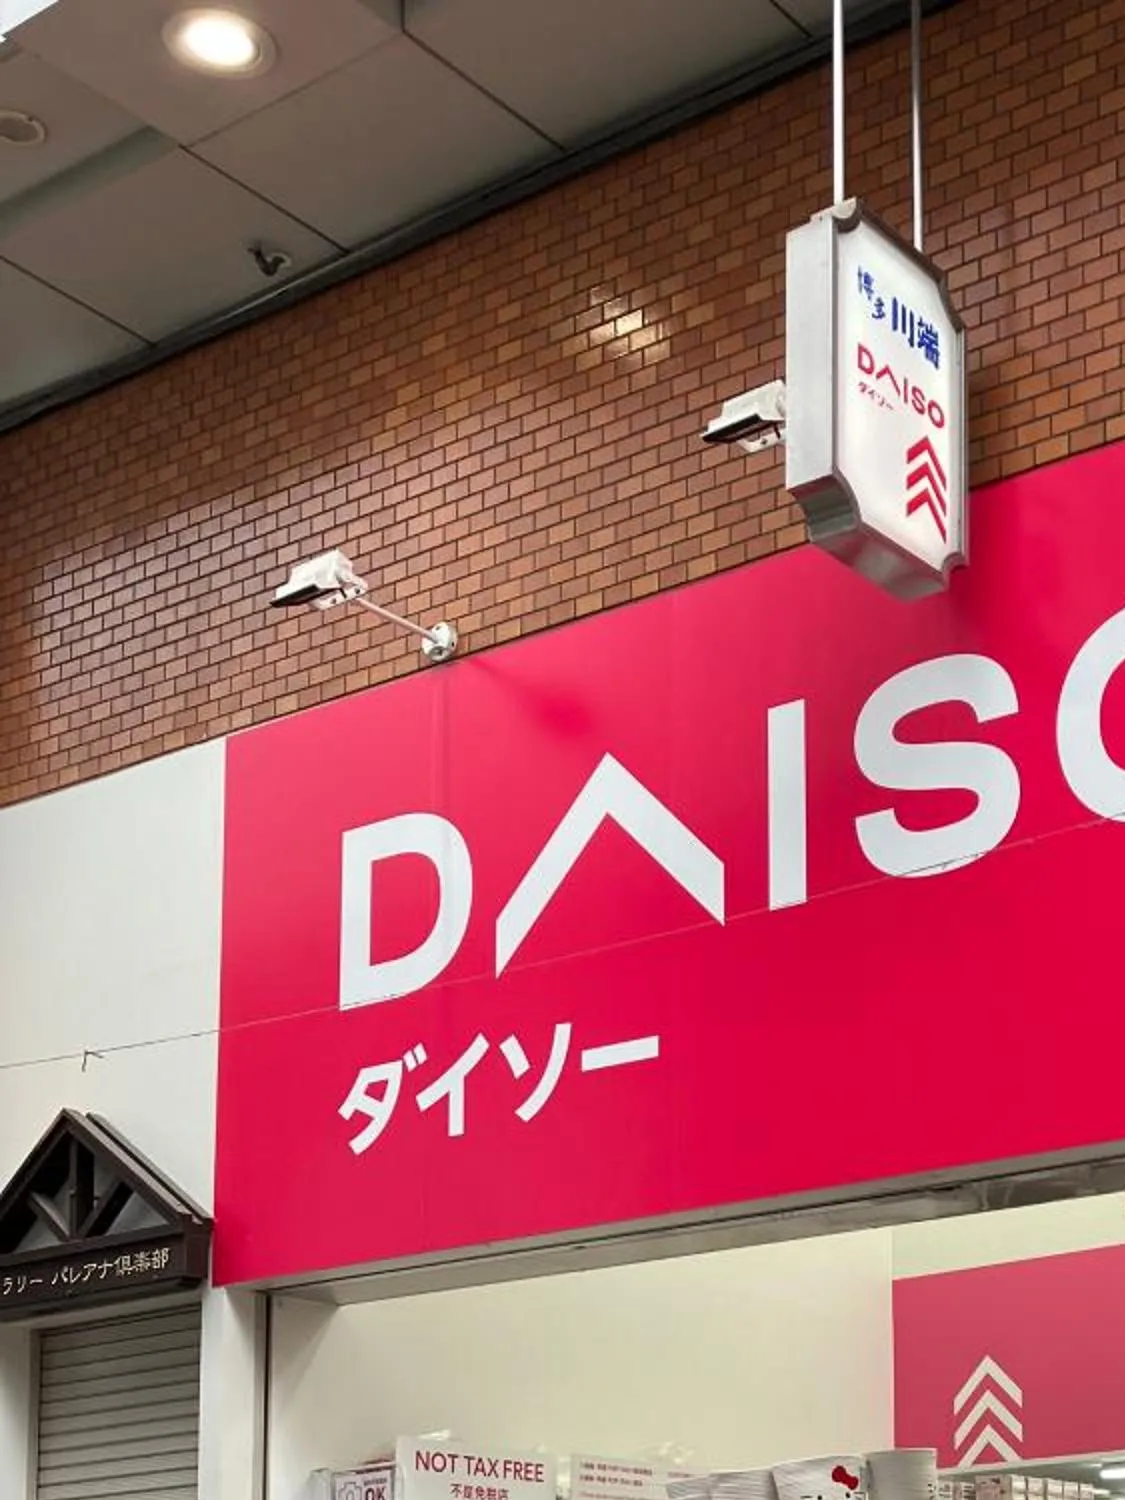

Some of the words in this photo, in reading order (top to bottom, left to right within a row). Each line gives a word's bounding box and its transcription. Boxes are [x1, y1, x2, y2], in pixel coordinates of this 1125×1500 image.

[857, 342, 946, 429] DAISO
[337, 1022, 660, 1156] ダイソー
[415, 1450, 459, 1473] NOT
[463, 1455, 499, 1479] TAX
[503, 1460, 545, 1483] FREE
